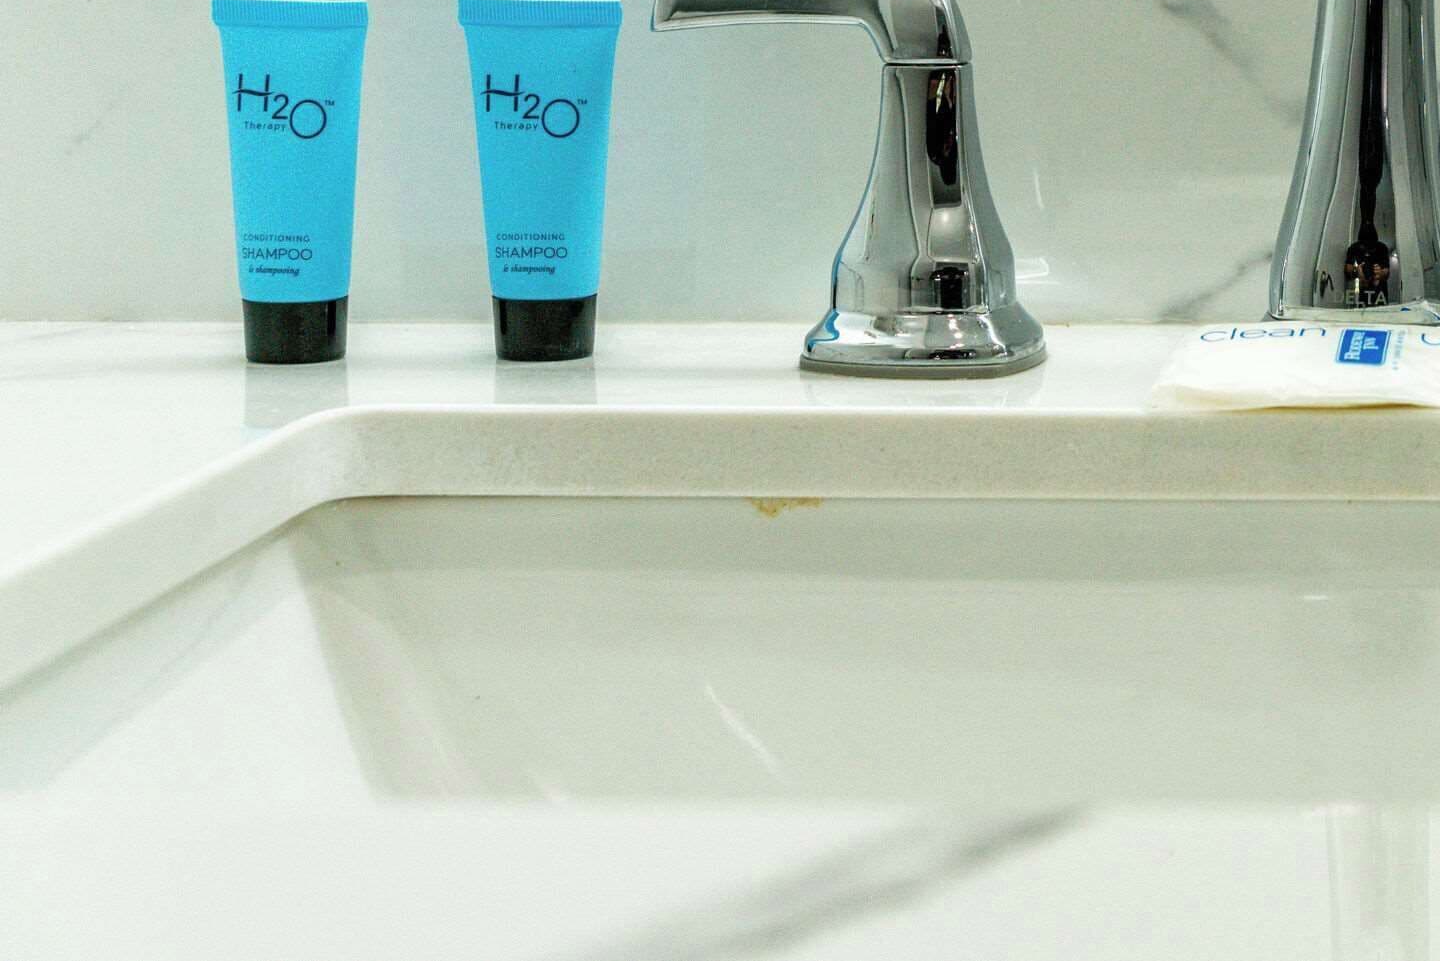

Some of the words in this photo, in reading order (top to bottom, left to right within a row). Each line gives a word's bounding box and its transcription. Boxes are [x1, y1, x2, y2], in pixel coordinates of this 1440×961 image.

[244, 121, 286, 132] Therapy
[494, 121, 538, 131] Therapy
[243, 233, 310, 242] CONDITIONING
[496, 233, 565, 241] CONDITIONING
[242, 247, 312, 260] SHAMPOO
[495, 246, 568, 259] SHAMPOO
[1200, 327, 1326, 342] clean
